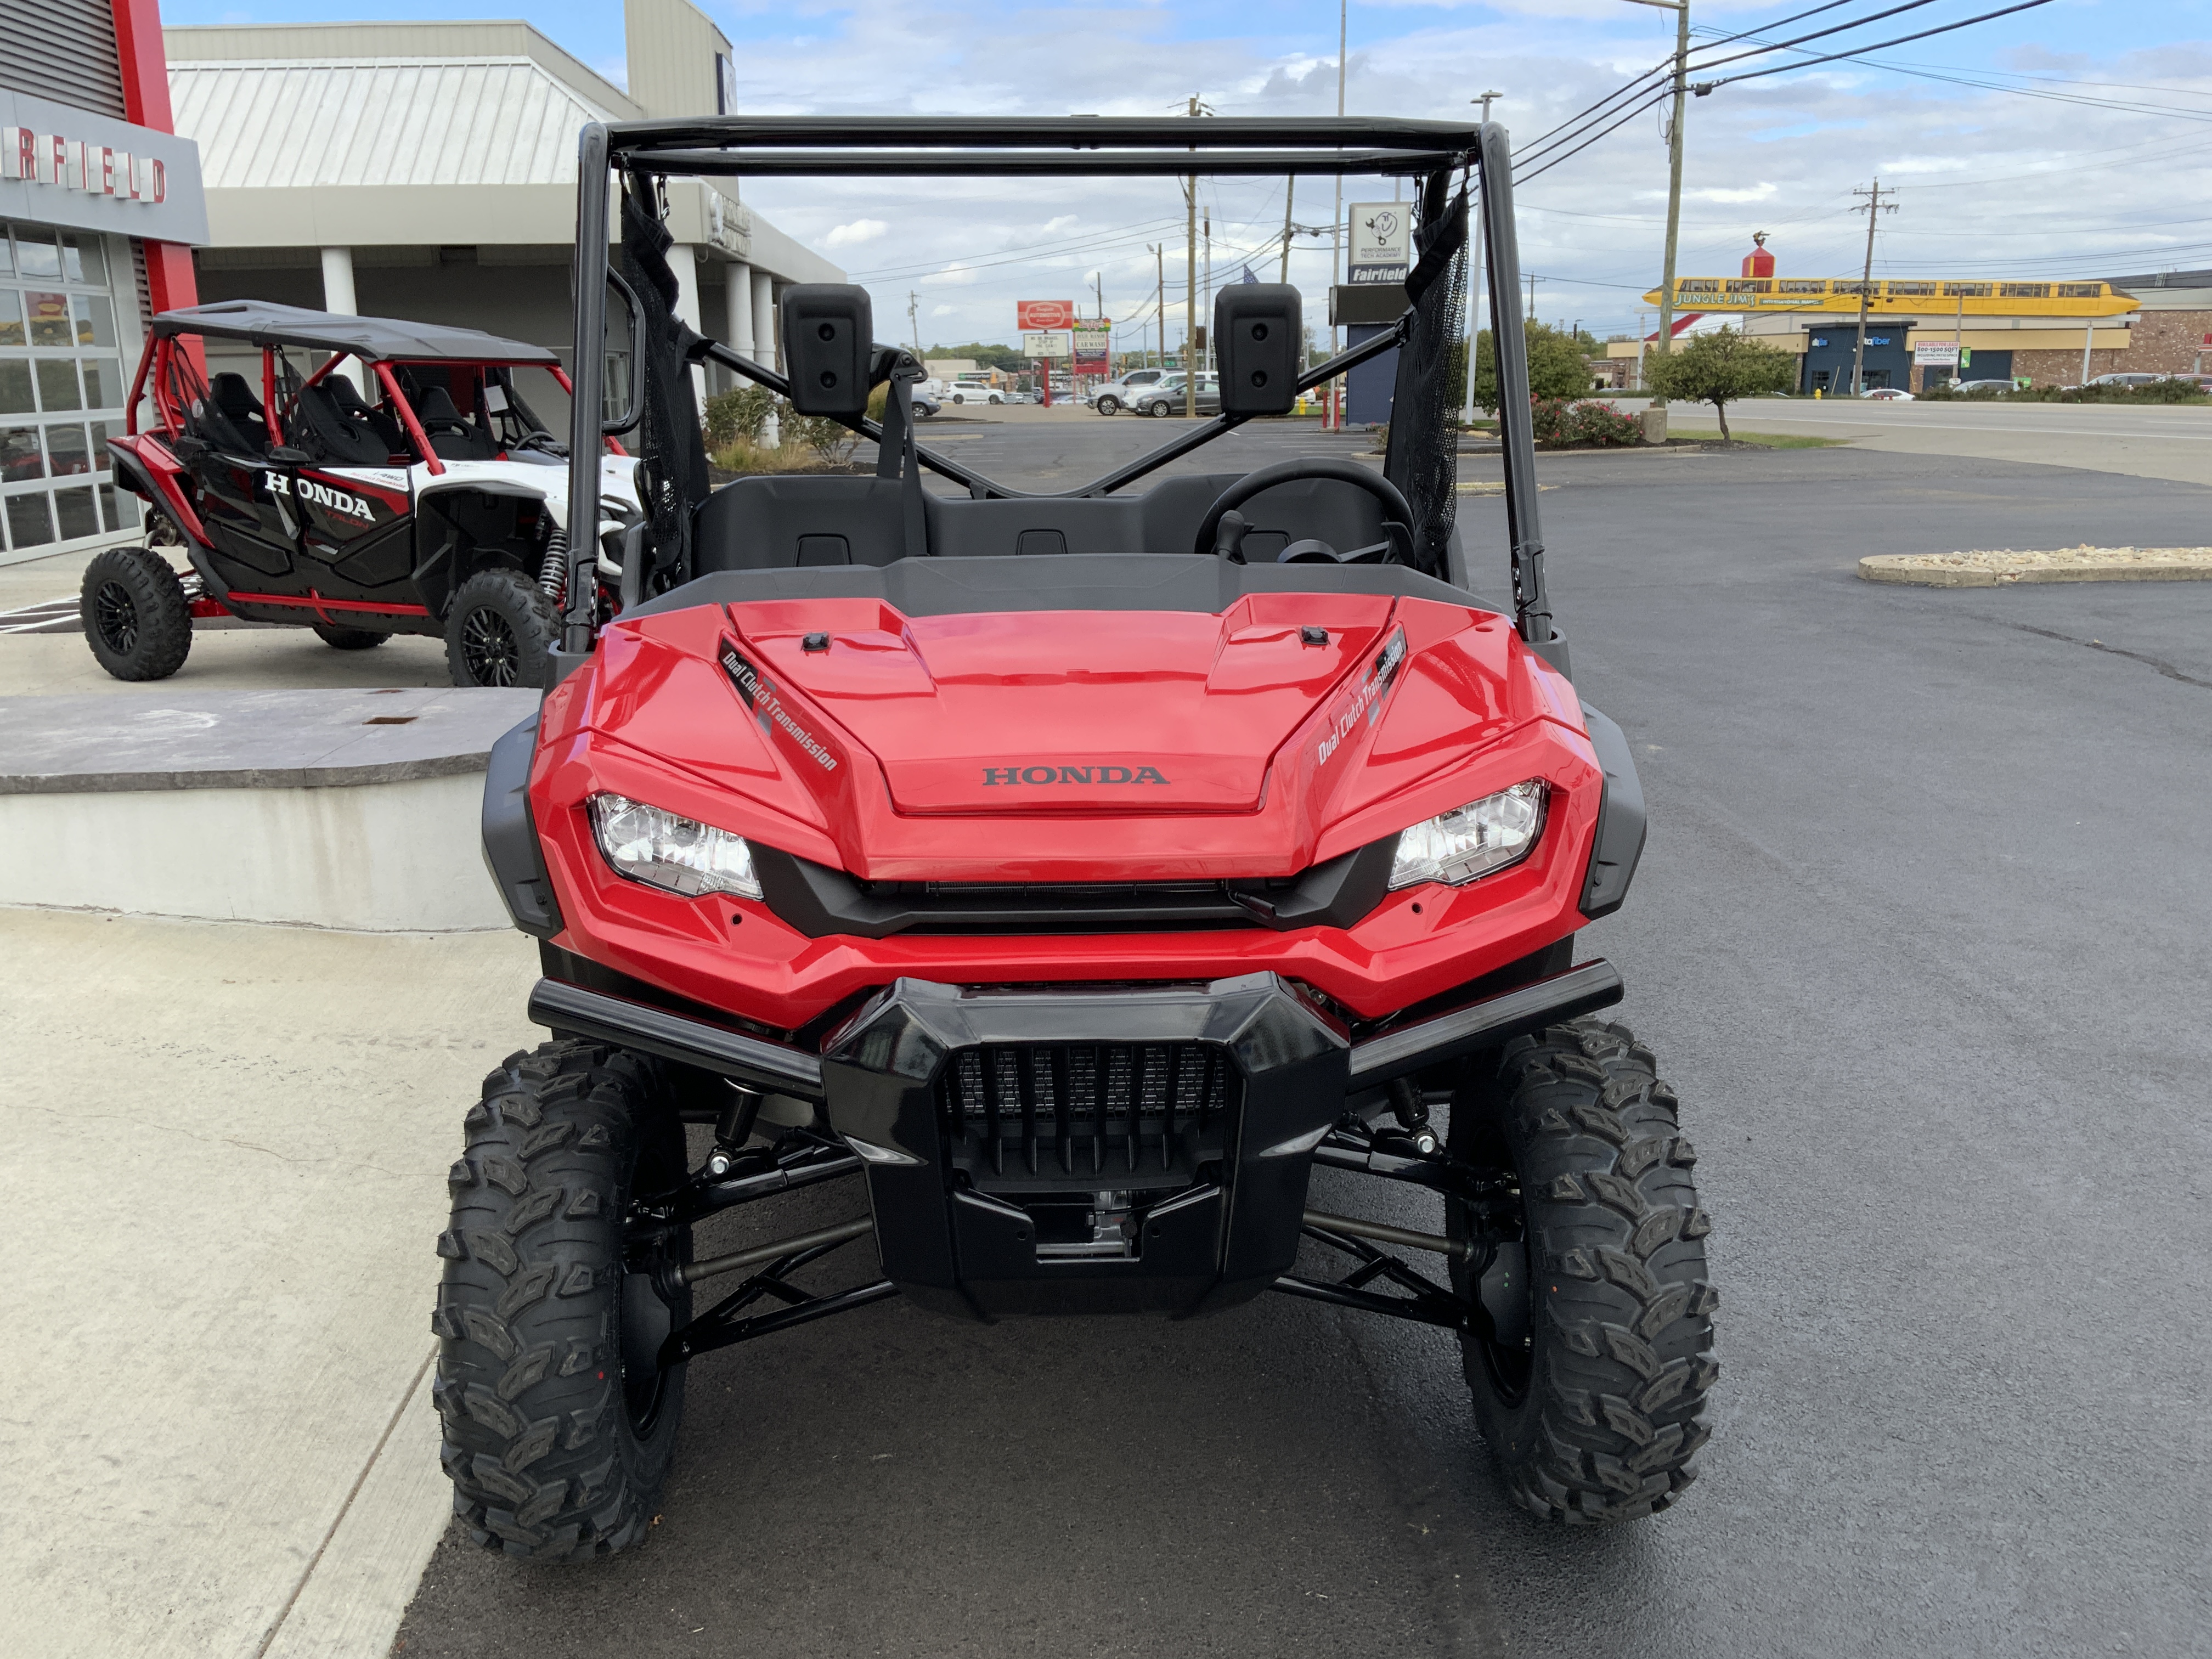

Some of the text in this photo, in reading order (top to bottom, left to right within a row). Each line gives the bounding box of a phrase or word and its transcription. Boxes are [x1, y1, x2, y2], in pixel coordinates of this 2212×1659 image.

[0, 127, 166, 204] RFIELD
[1353, 268, 1407, 281] Fairfield
[1674, 294, 1724, 306] JUNGLE
[1857, 336, 1891, 347] tafiber
[265, 470, 376, 522] HONDA
[325, 509, 369, 531] TALON
[723, 651, 838, 771] Dual Clutch Transmission
[1318, 640, 1404, 766] Dual Clutch Transmission
[982, 766, 1171, 786] HONDA
